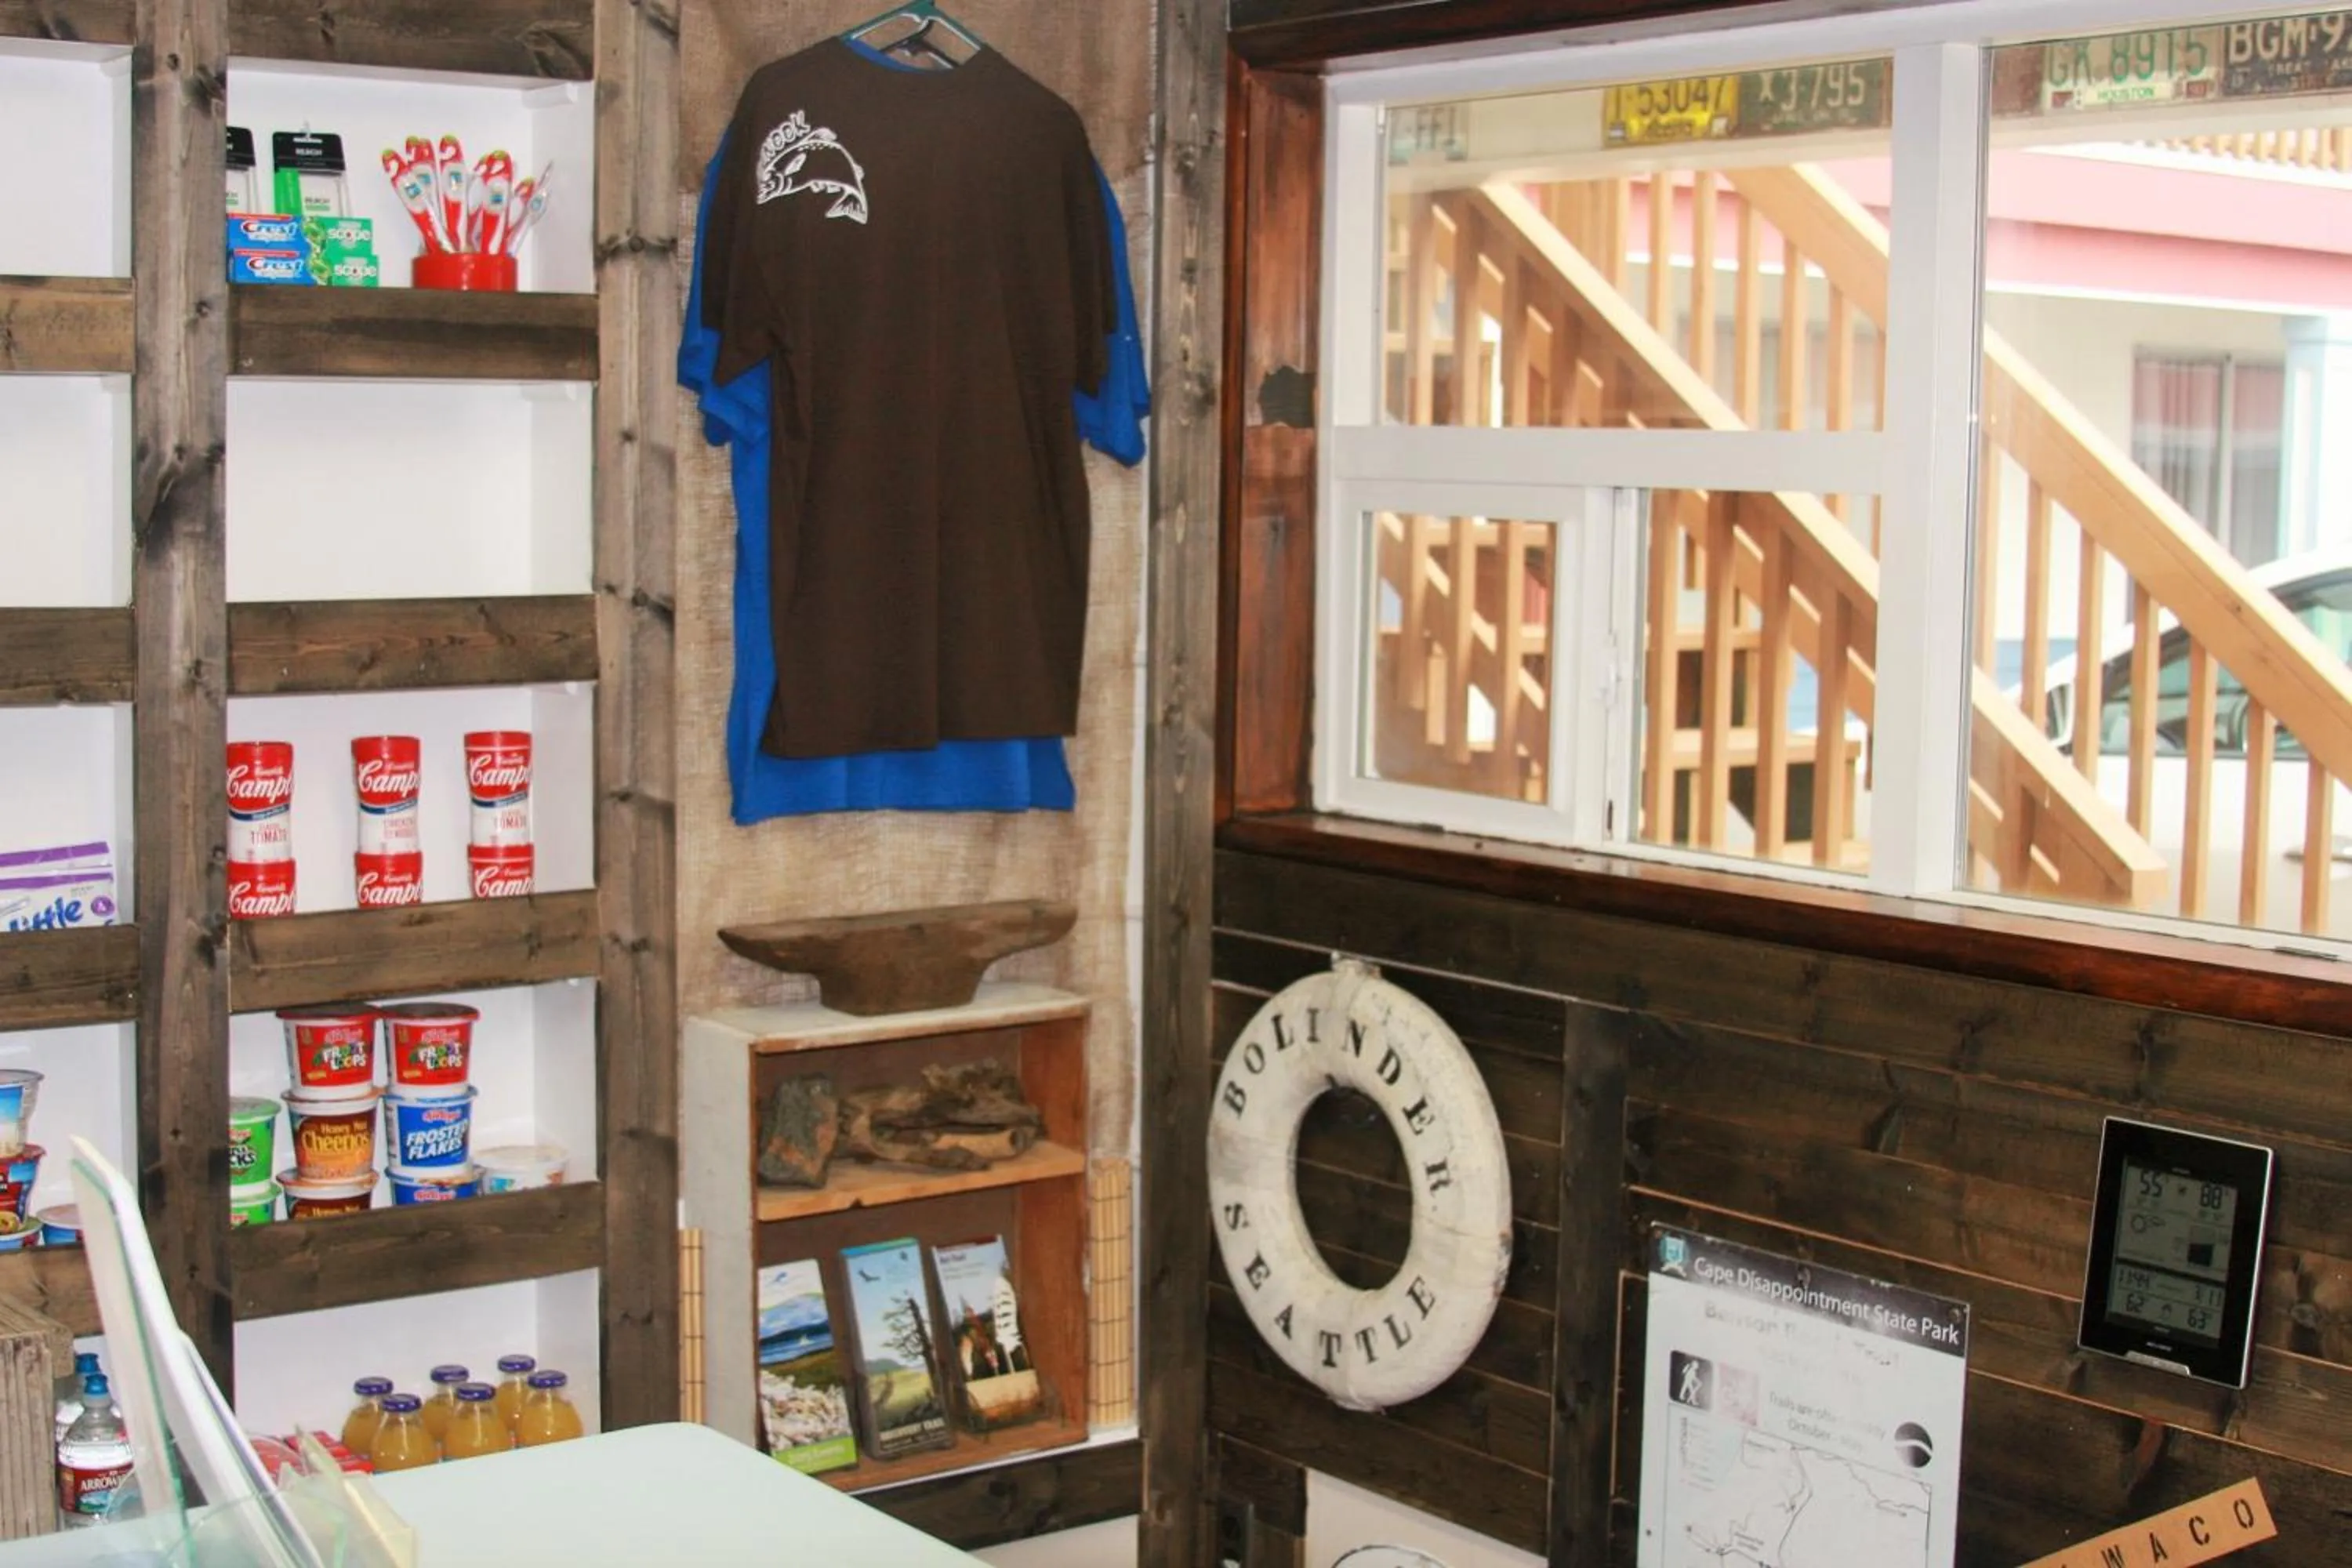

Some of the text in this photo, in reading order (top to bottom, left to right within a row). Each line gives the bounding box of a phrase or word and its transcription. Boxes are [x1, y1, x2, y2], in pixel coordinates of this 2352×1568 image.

[241, 220, 298, 237] Crest
[328, 227, 372, 241] scope
[248, 256, 303, 274] Crest
[334, 263, 378, 277] scope
[1221, 1008, 1453, 1196] BOLINDER
[302, 1130, 370, 1152] Cheerios
[408, 1137, 463, 1160] FLAKES
[1225, 1202, 1436, 1367] SEATTLE
[1693, 1256, 1735, 1285] Cape
[1737, 1267, 1869, 1319] Disappointment
[1873, 1303, 1918, 1333] State
[1922, 1316, 1960, 1345] Park
